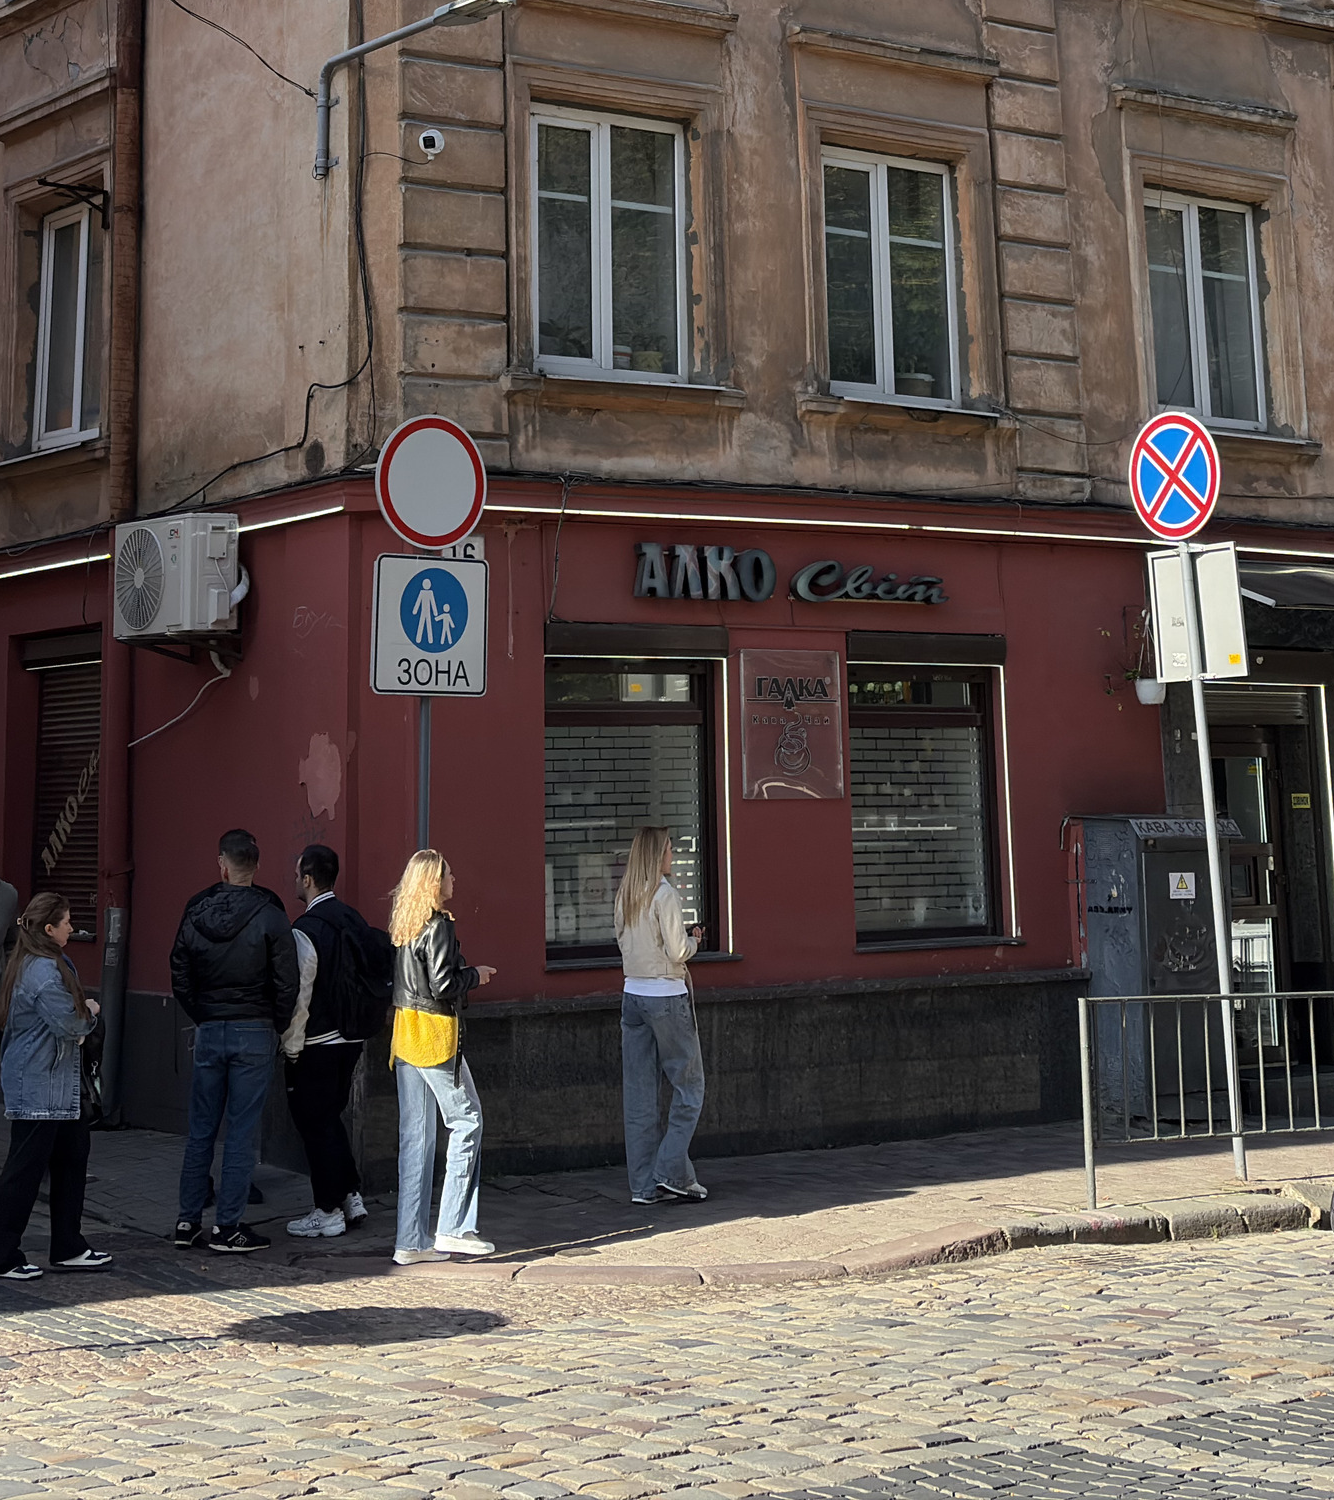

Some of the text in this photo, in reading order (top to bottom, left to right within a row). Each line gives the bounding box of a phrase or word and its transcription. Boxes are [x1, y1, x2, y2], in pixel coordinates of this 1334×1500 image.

[634, 542, 950, 605] АЛКО Світ
[397, 657, 470, 687] ЗОНА
[755, 676, 830, 702] ГАЛКА
[752, 714, 831, 726] Кава Чай
[1134, 821, 1175, 834] КАВА
